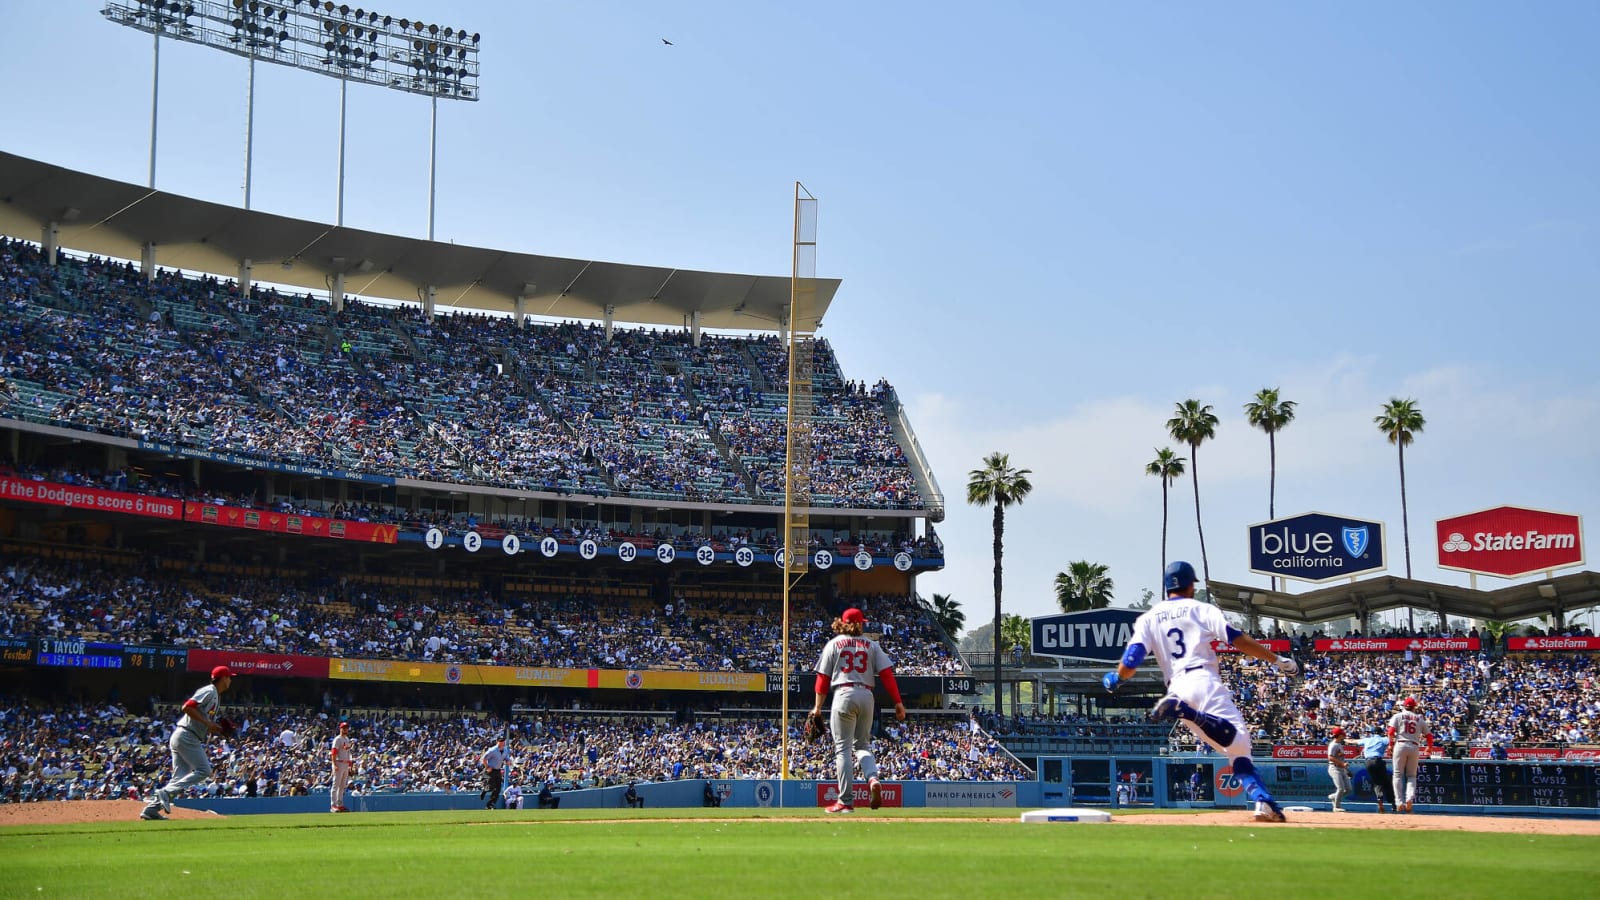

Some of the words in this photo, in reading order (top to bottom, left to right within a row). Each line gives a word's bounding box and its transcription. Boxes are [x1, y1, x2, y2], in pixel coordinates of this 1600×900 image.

[181, 448, 211, 458] ASSISTANCE
[10, 482, 34, 497] the
[37, 486, 94, 506] Dodgers
[97, 495, 132, 510] score
[136, 499, 143, 511] 6
[146, 502, 174, 515] runs
[432, 533, 437, 544] 1
[469, 536, 476, 547] 2
[1261, 528, 1333, 554] blue
[507, 540, 515, 550] 4
[544, 542, 554, 552] 14
[583, 544, 594, 555] 19
[620, 547, 634, 557] 20
[659, 548, 673, 559] 24
[699, 550, 712, 561] 32
[738, 552, 752, 562] 39
[816, 554, 831, 565] 53
[1273, 555, 1343, 568] california
[1155, 606, 1189, 623] TAYLOR
[1042, 623, 1136, 648] CUTWA
[42, 641, 48, 652] 3
[54, 641, 85, 654] TAYLOR
[1167, 628, 1186, 659] 3
[131, 654, 142, 666] 98
[166, 656, 175, 668] 16
[840, 651, 868, 673] 33
[949, 680, 970, 690] 3:40
[1404, 721, 1416, 734] 16
[1470, 766, 1488, 774] BAL
[1495, 766, 1501, 774] 5
[1531, 767, 1542, 775] TB
[1219, 774, 1240, 790] 76
[1532, 776, 1555, 785] CWS
[852, 787, 895, 800] aterm
[1472, 787, 1485, 796] KC
[1533, 788, 1554, 797] NYY
[1558, 789, 1564, 797] 2
[1473, 796, 1493, 804] MIN
[1534, 798, 1551, 806] TEX
[1558, 798, 1569, 806] 15
